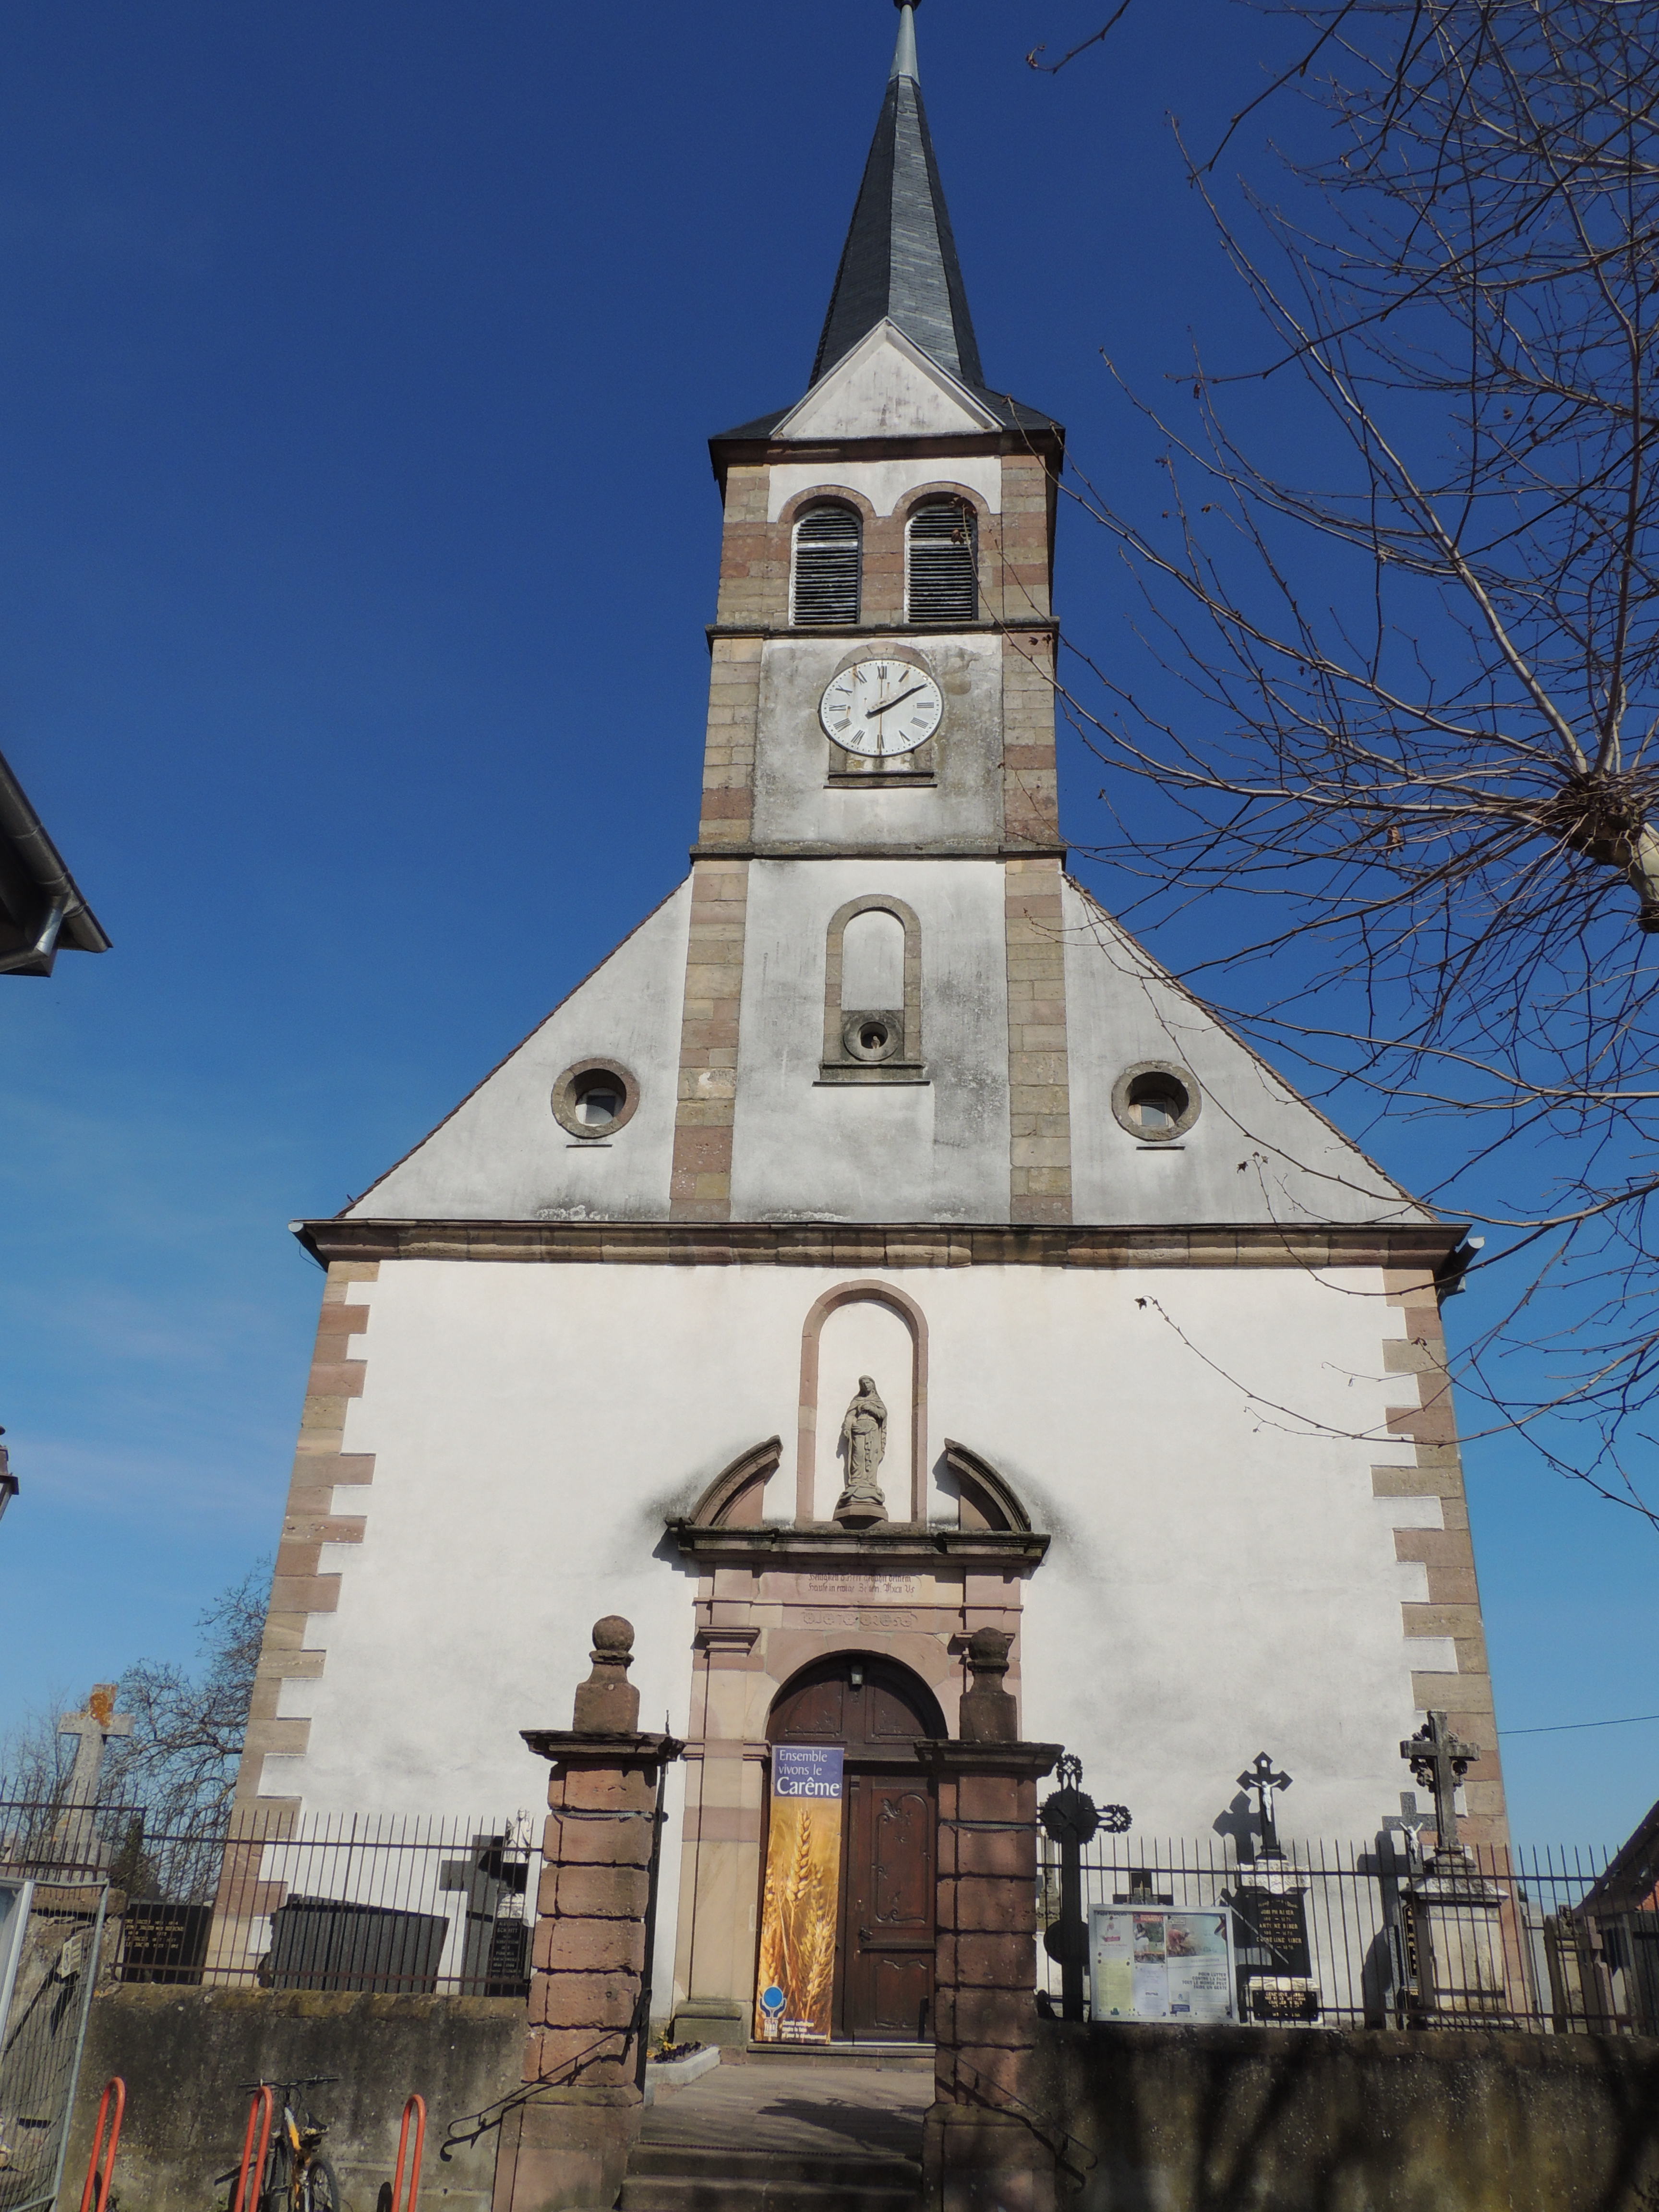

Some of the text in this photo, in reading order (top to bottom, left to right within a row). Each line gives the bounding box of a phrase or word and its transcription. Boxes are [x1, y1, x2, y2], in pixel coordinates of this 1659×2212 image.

[877, 666, 887, 679] XII
[835, 685, 853, 696] X
[851, 730, 866, 745] VII
[780, 1750, 828, 1762] Ensemble
[779, 1764, 822, 1776] vivons le
[777, 1777, 840, 1796] Carême
